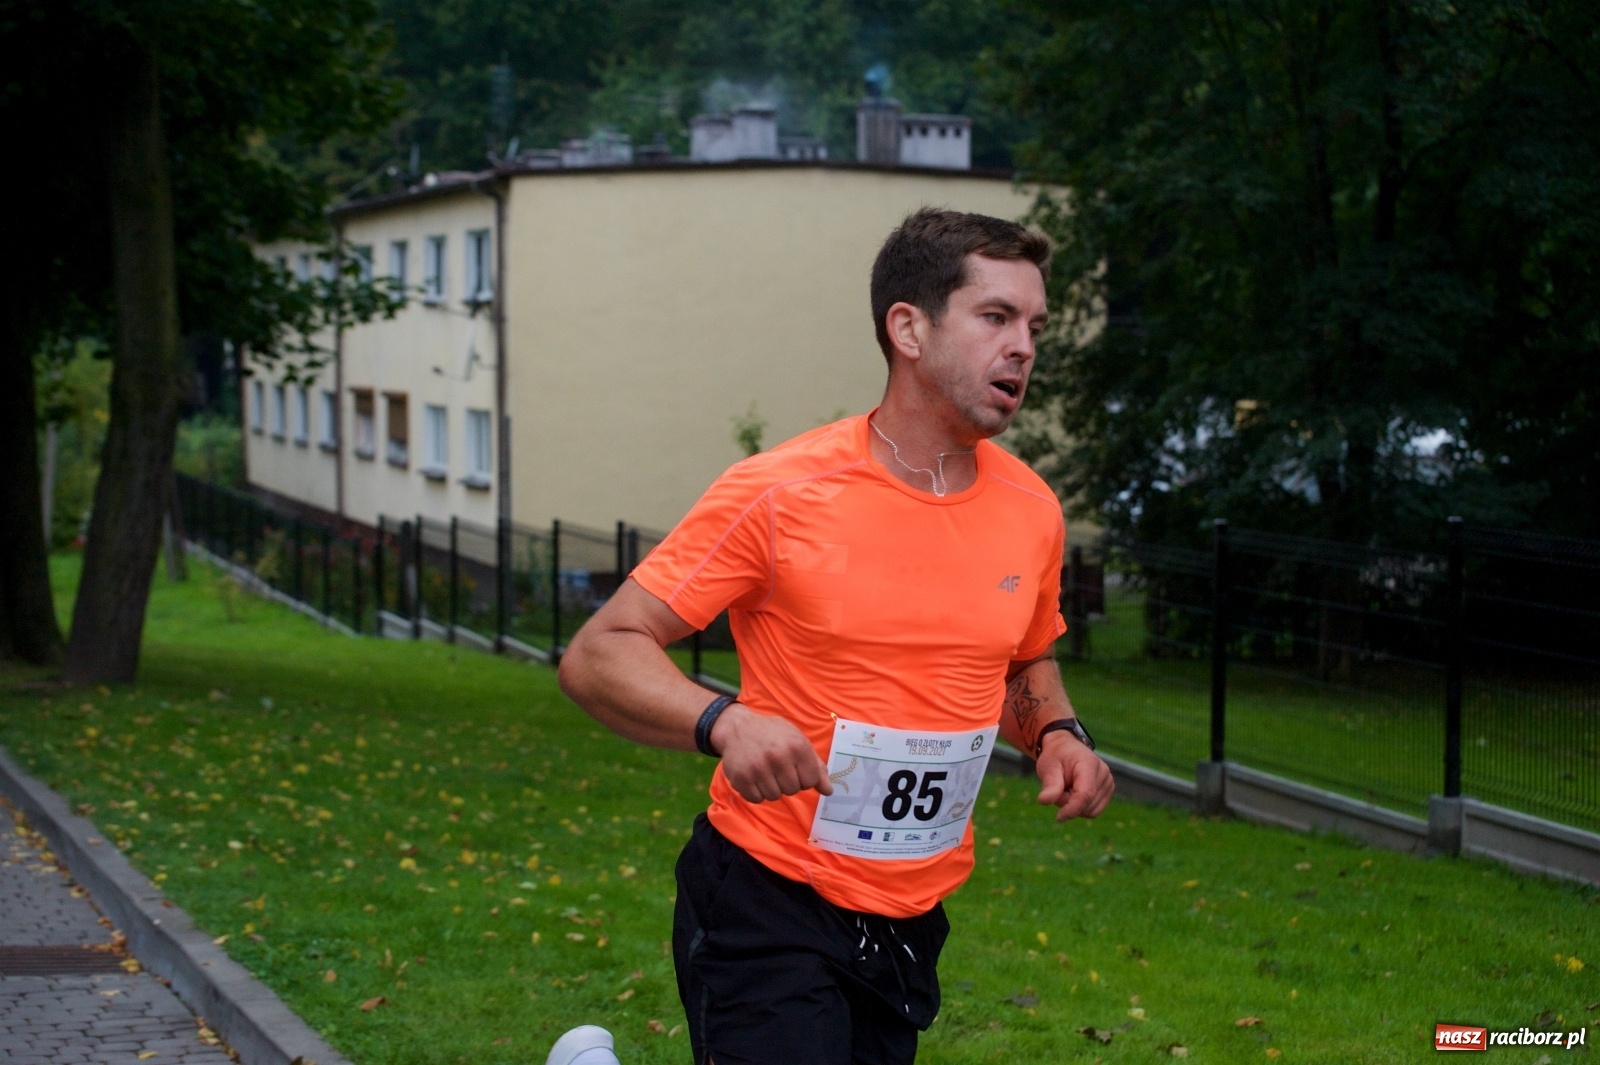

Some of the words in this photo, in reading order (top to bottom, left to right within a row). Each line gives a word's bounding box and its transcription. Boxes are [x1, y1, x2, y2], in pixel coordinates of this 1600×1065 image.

[998, 575, 1021, 593] 4F
[905, 738, 918, 747] BIEG
[908, 746, 946, 756] 19.09.2021
[882, 769, 948, 821] 85
